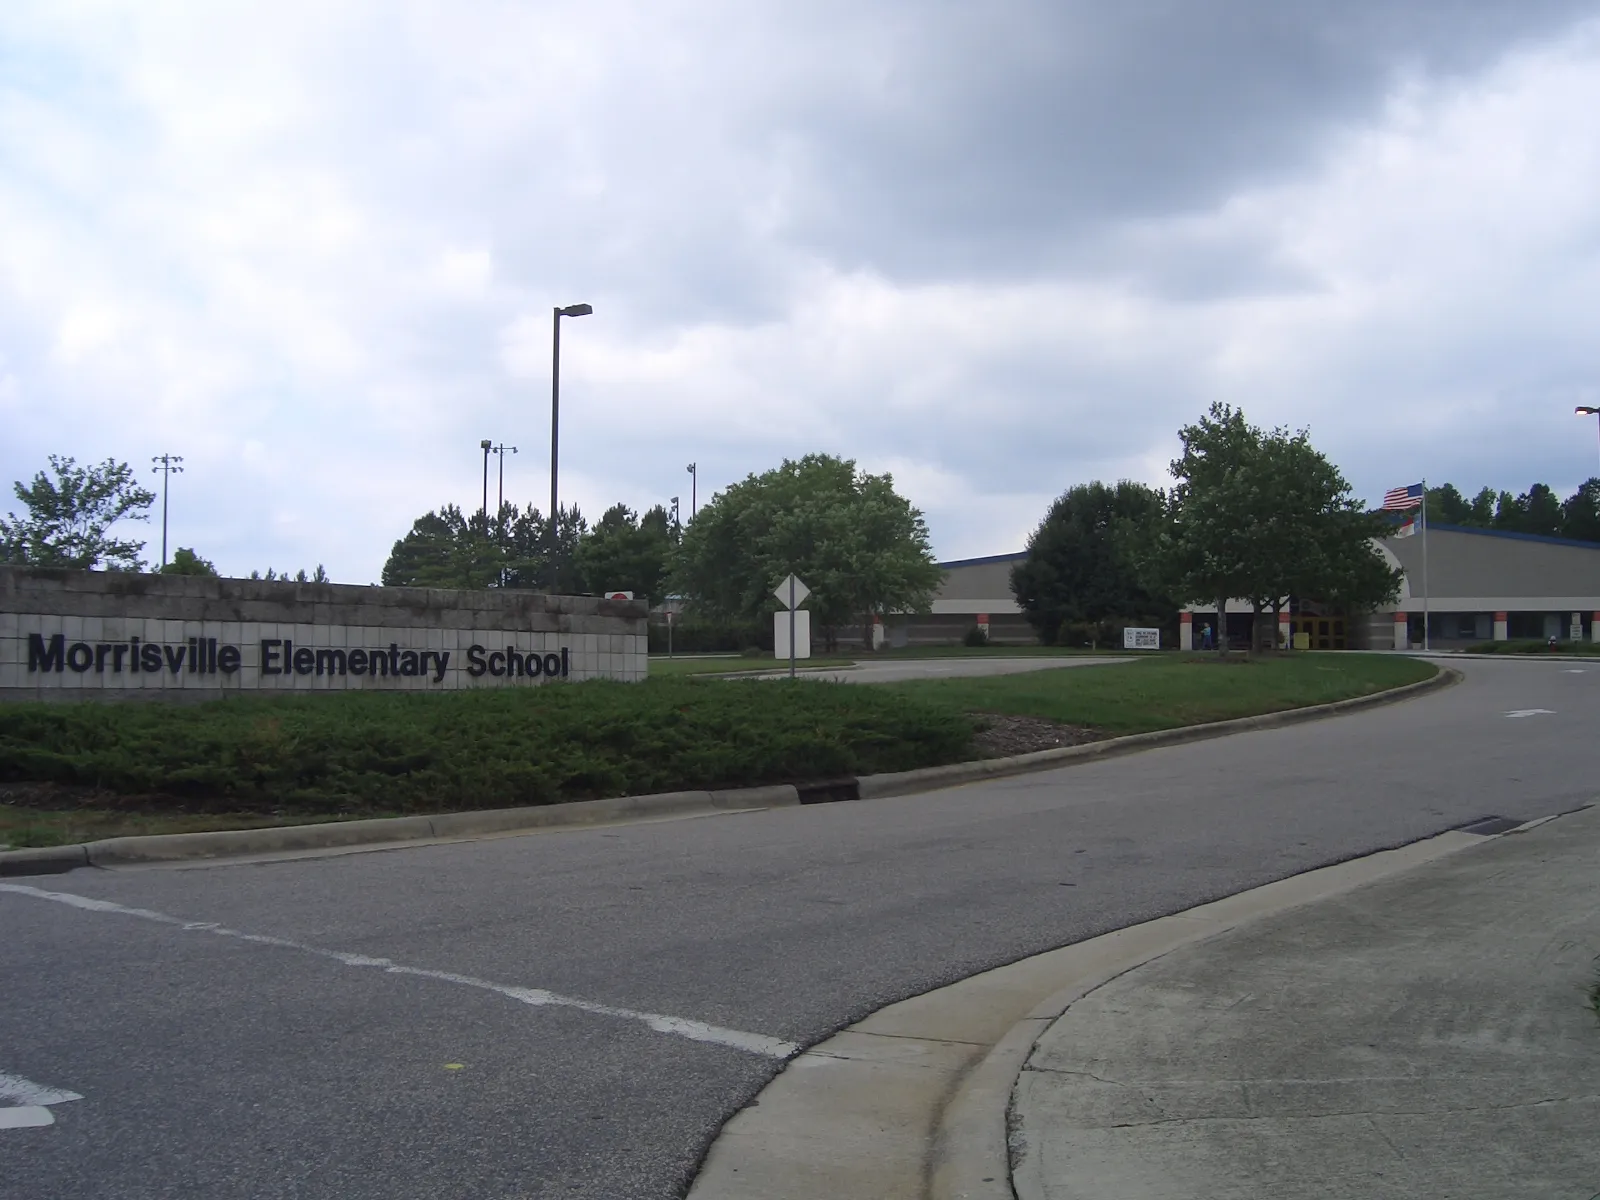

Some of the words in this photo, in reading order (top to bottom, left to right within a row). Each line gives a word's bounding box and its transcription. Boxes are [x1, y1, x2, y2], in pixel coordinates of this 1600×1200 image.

[28, 633, 241, 674] Morrisville
[261, 639, 450, 683] Elementary
[467, 644, 569, 677] School
